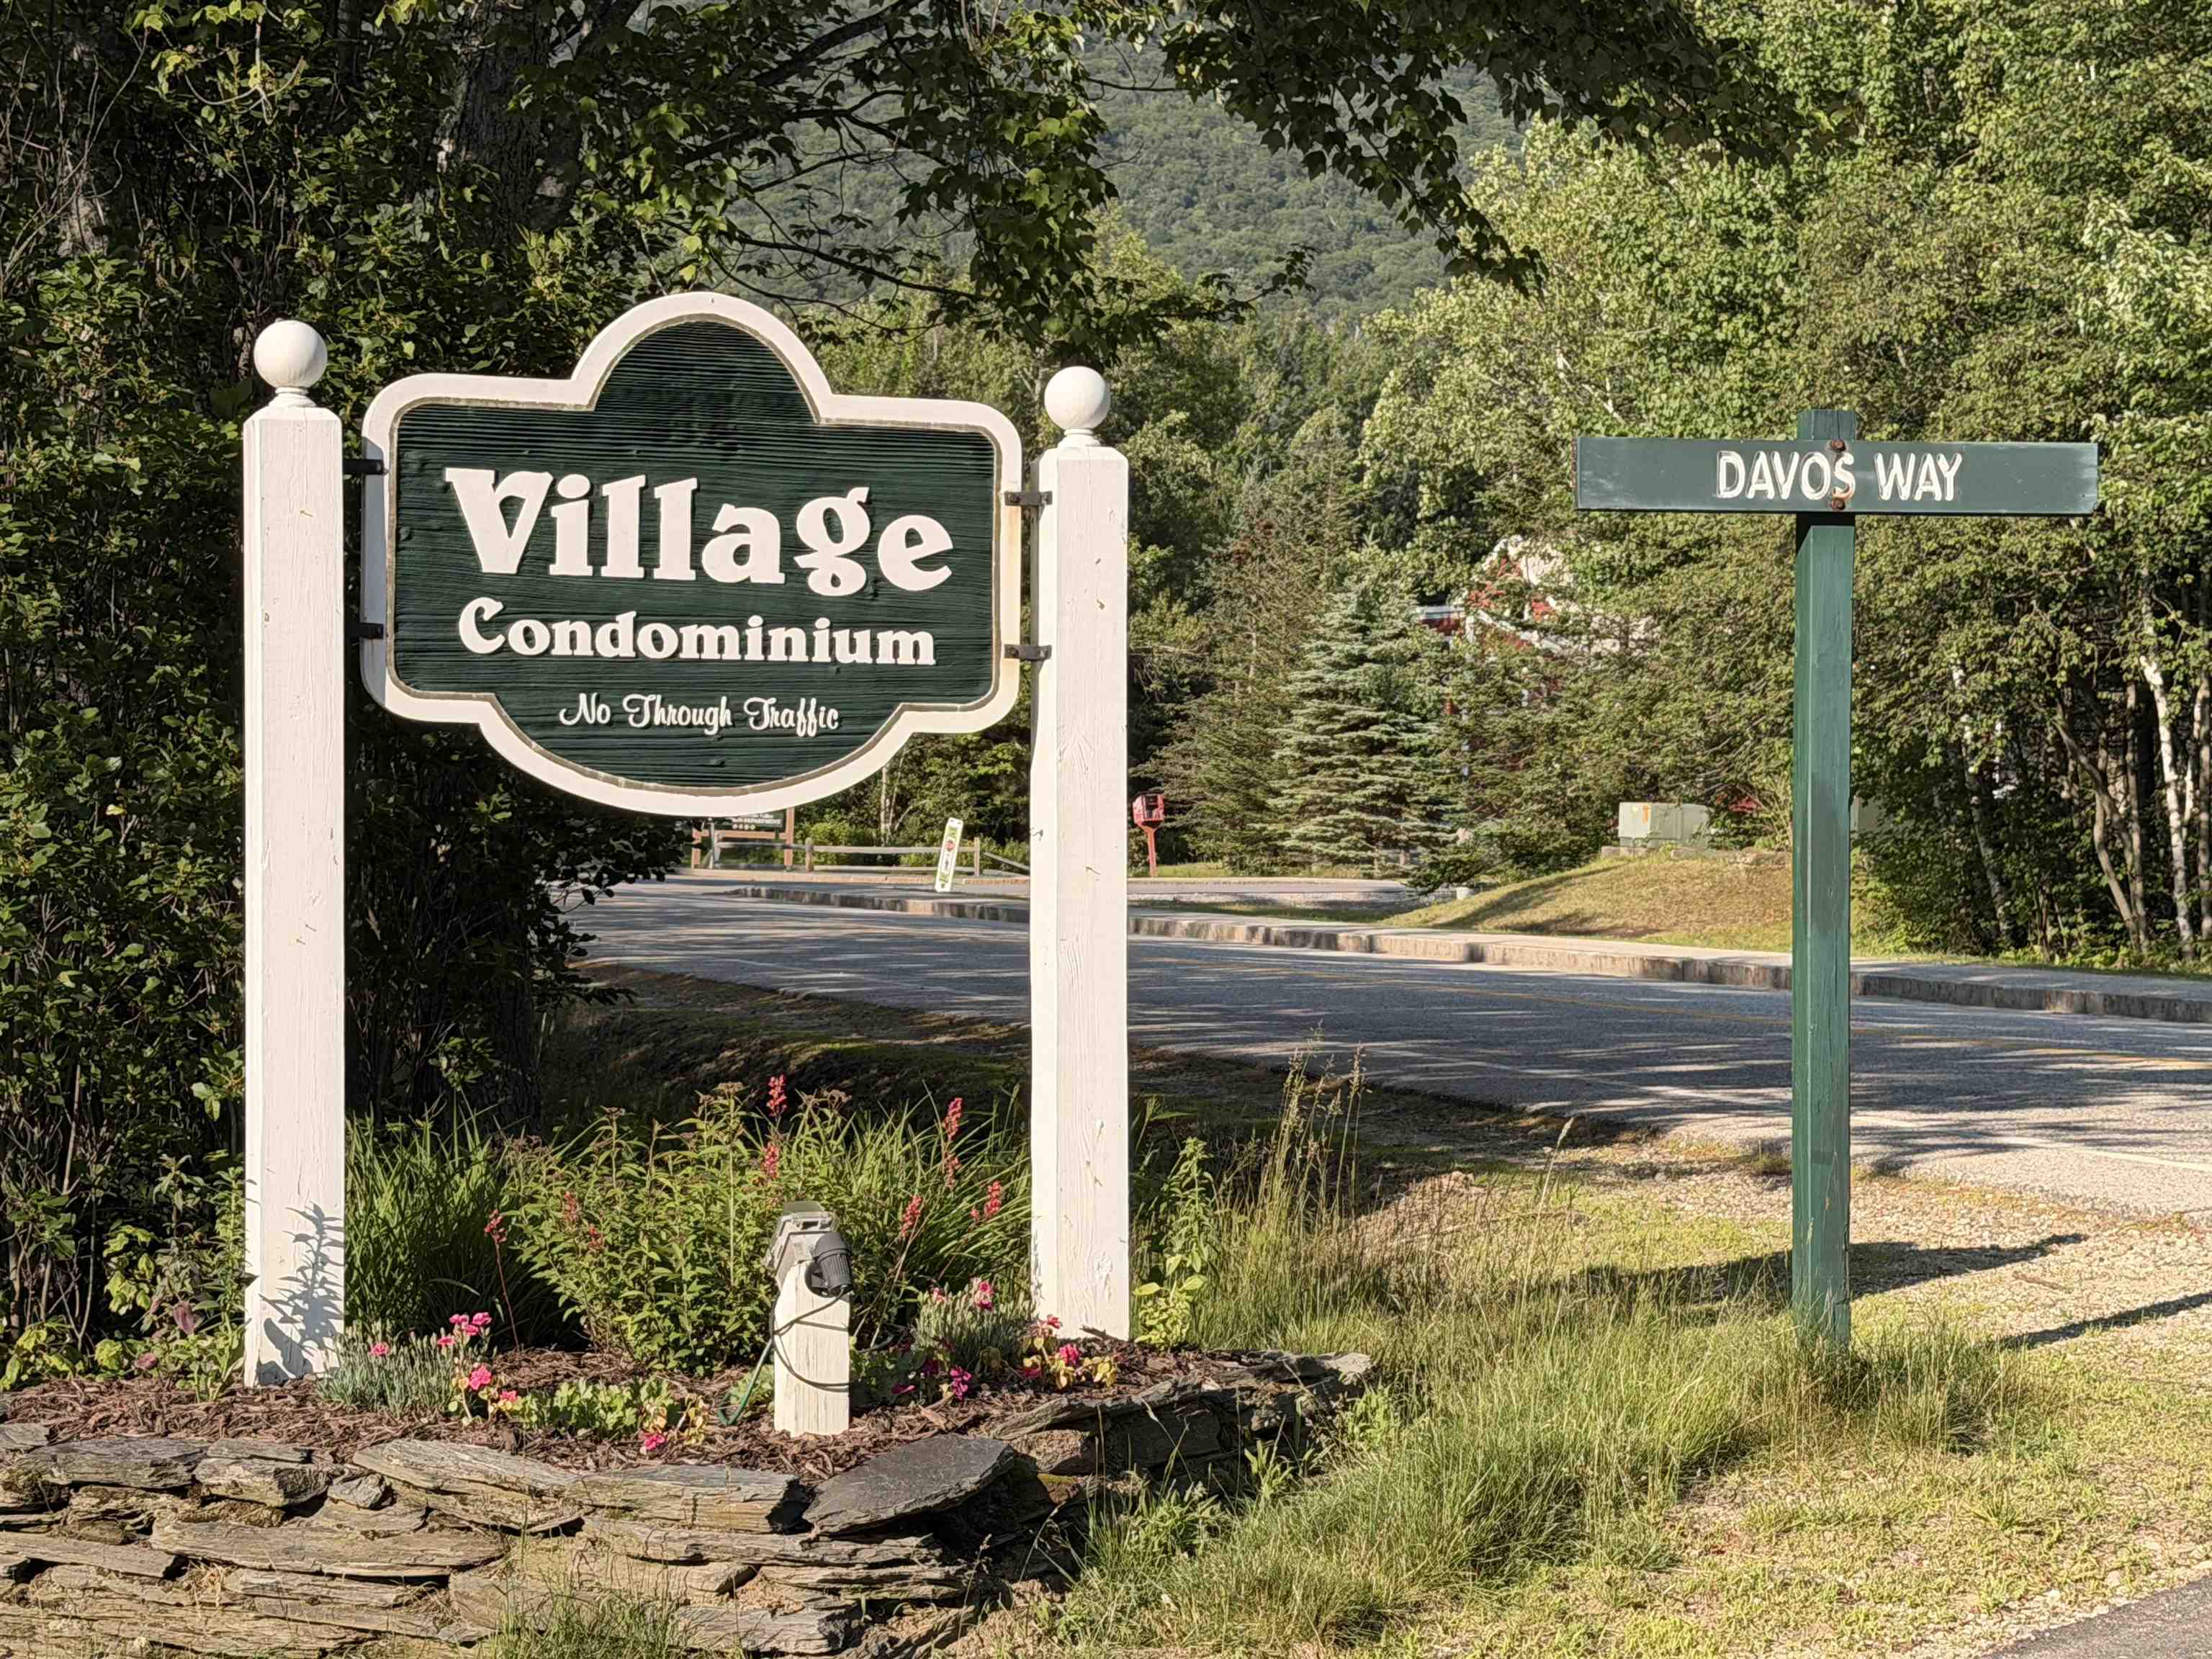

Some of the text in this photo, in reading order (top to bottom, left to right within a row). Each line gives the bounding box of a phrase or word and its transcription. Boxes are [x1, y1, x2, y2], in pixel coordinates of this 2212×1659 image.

[1716, 451, 1962, 501] DAVOS WAY
[444, 467, 953, 597] Village
[458, 596, 936, 665] Condominium
[559, 692, 839, 737] No Through Traffic
